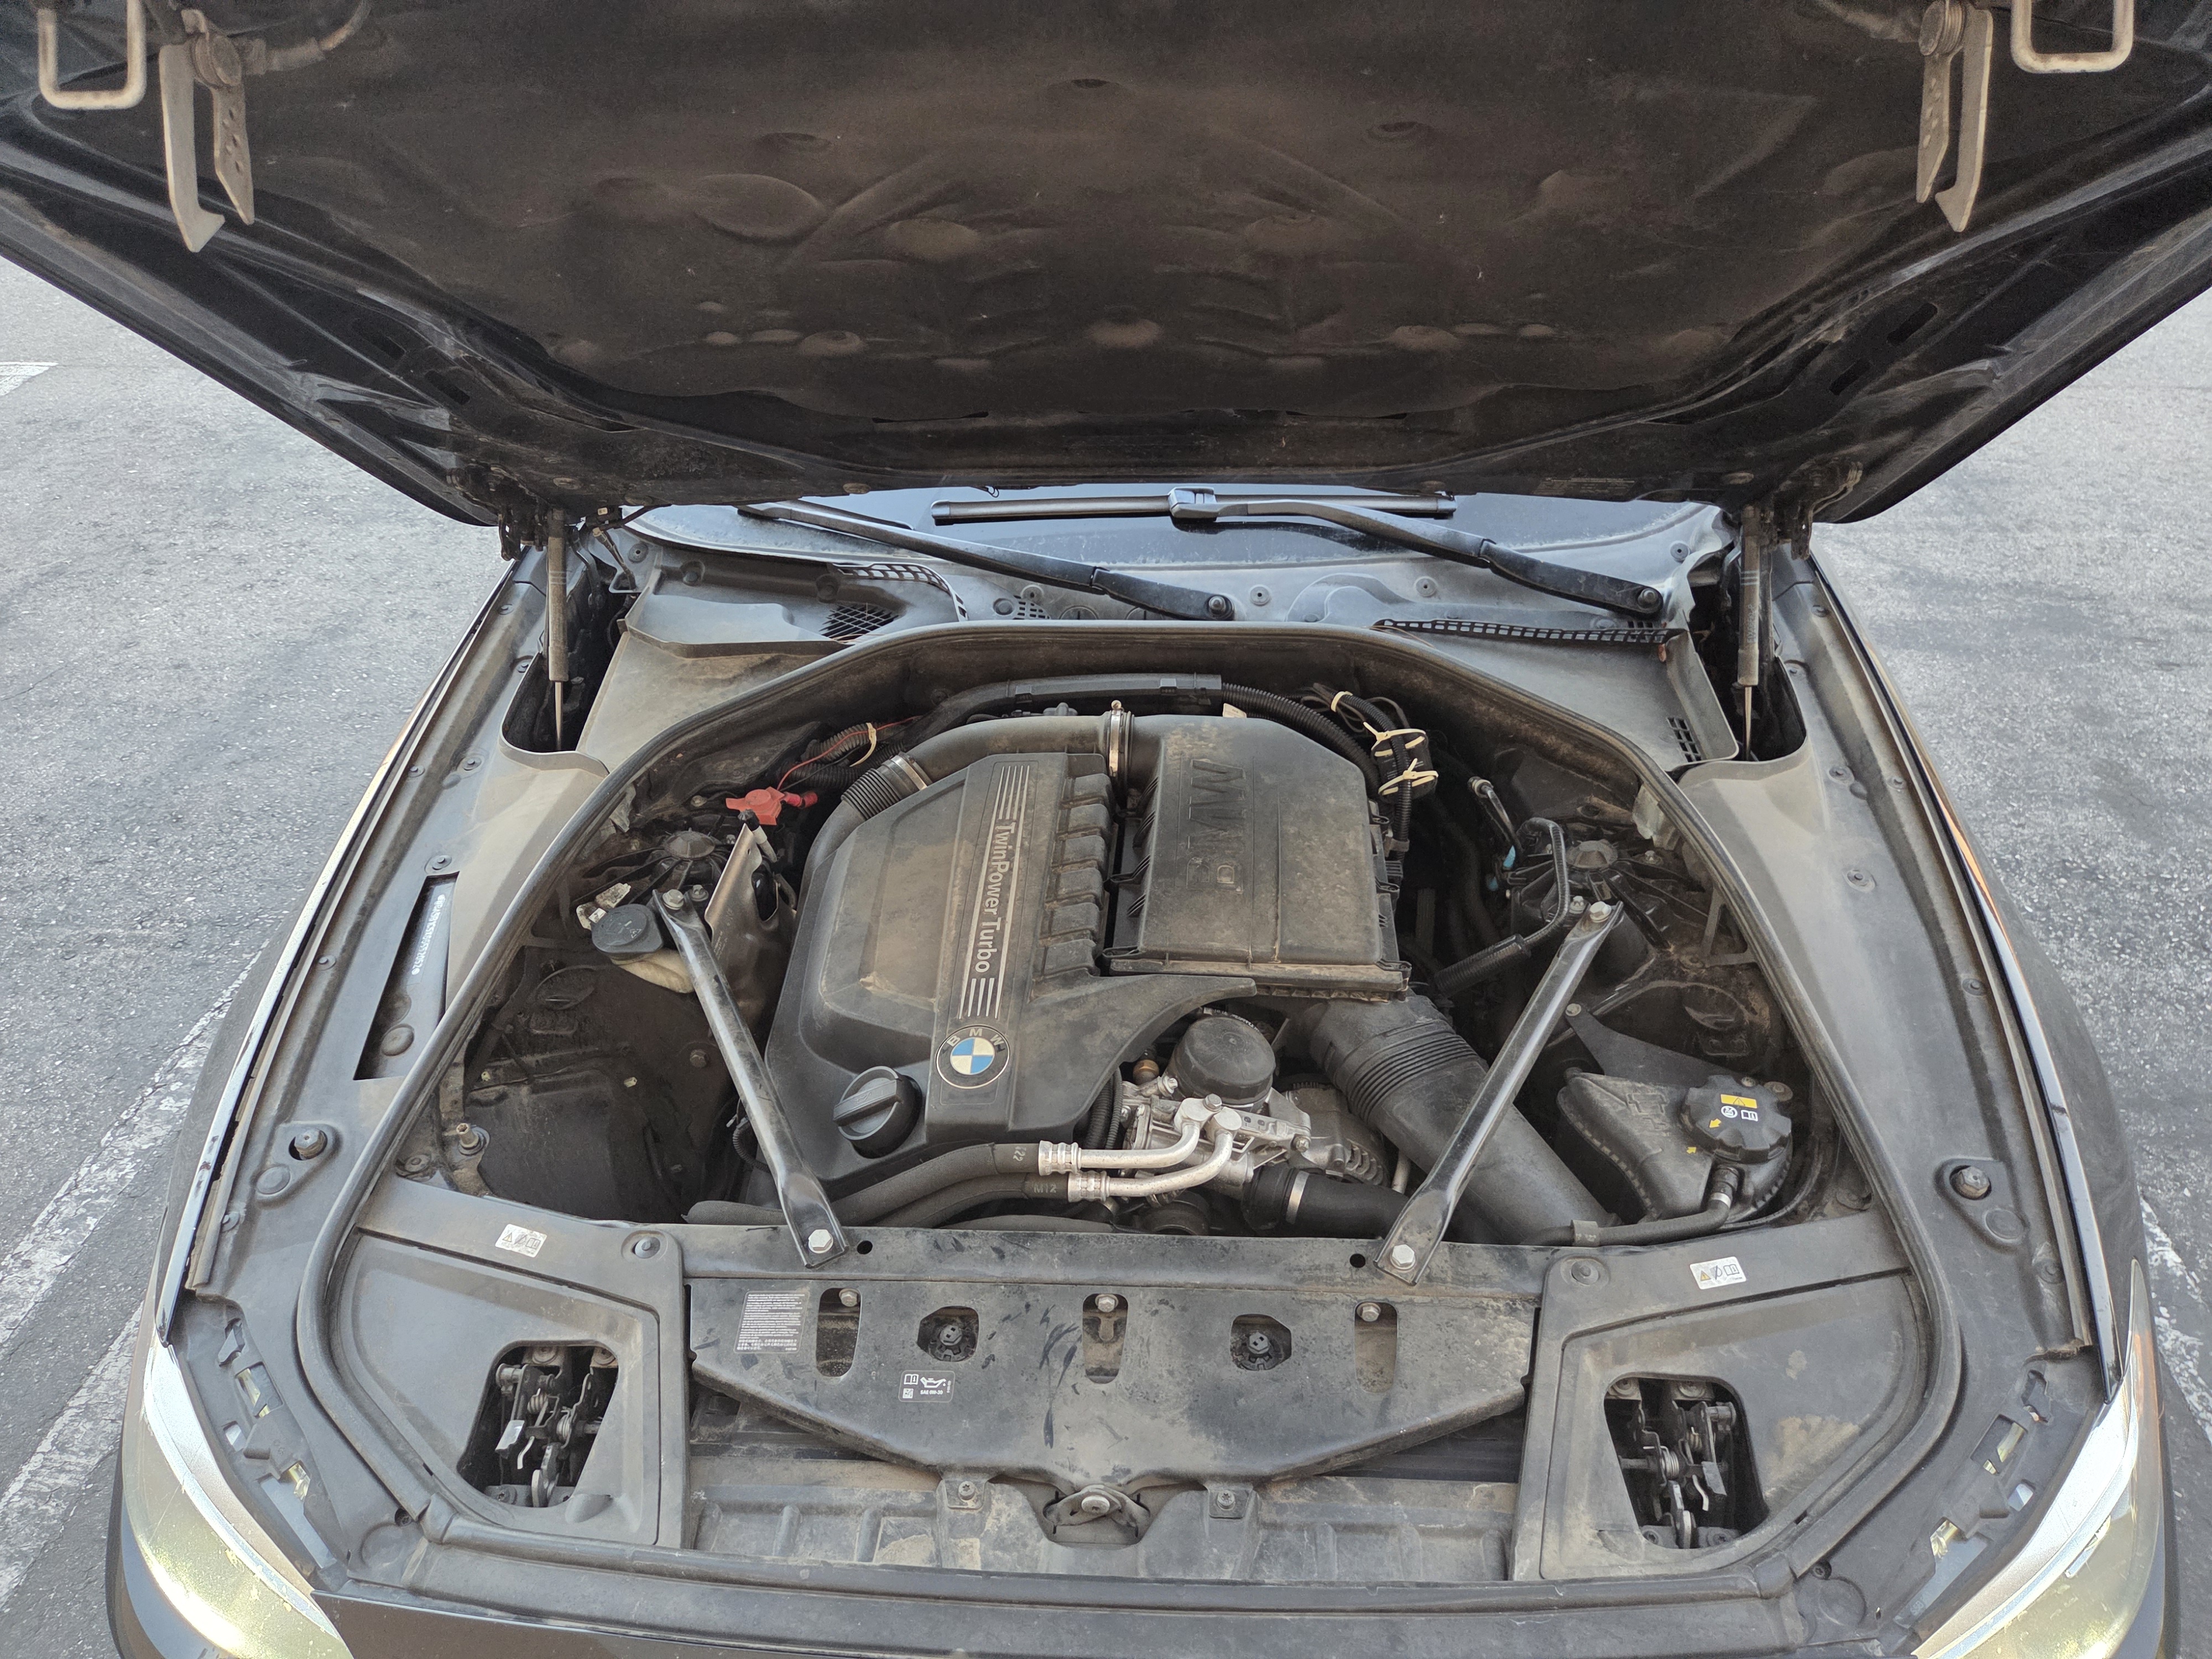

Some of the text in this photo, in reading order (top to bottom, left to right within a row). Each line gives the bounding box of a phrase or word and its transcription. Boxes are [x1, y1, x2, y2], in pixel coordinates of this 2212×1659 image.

[1186, 759, 1246, 894] BMW
[975, 822, 1016, 973] TwinPower Turbo
[946, 1028, 1005, 1048] BMW
